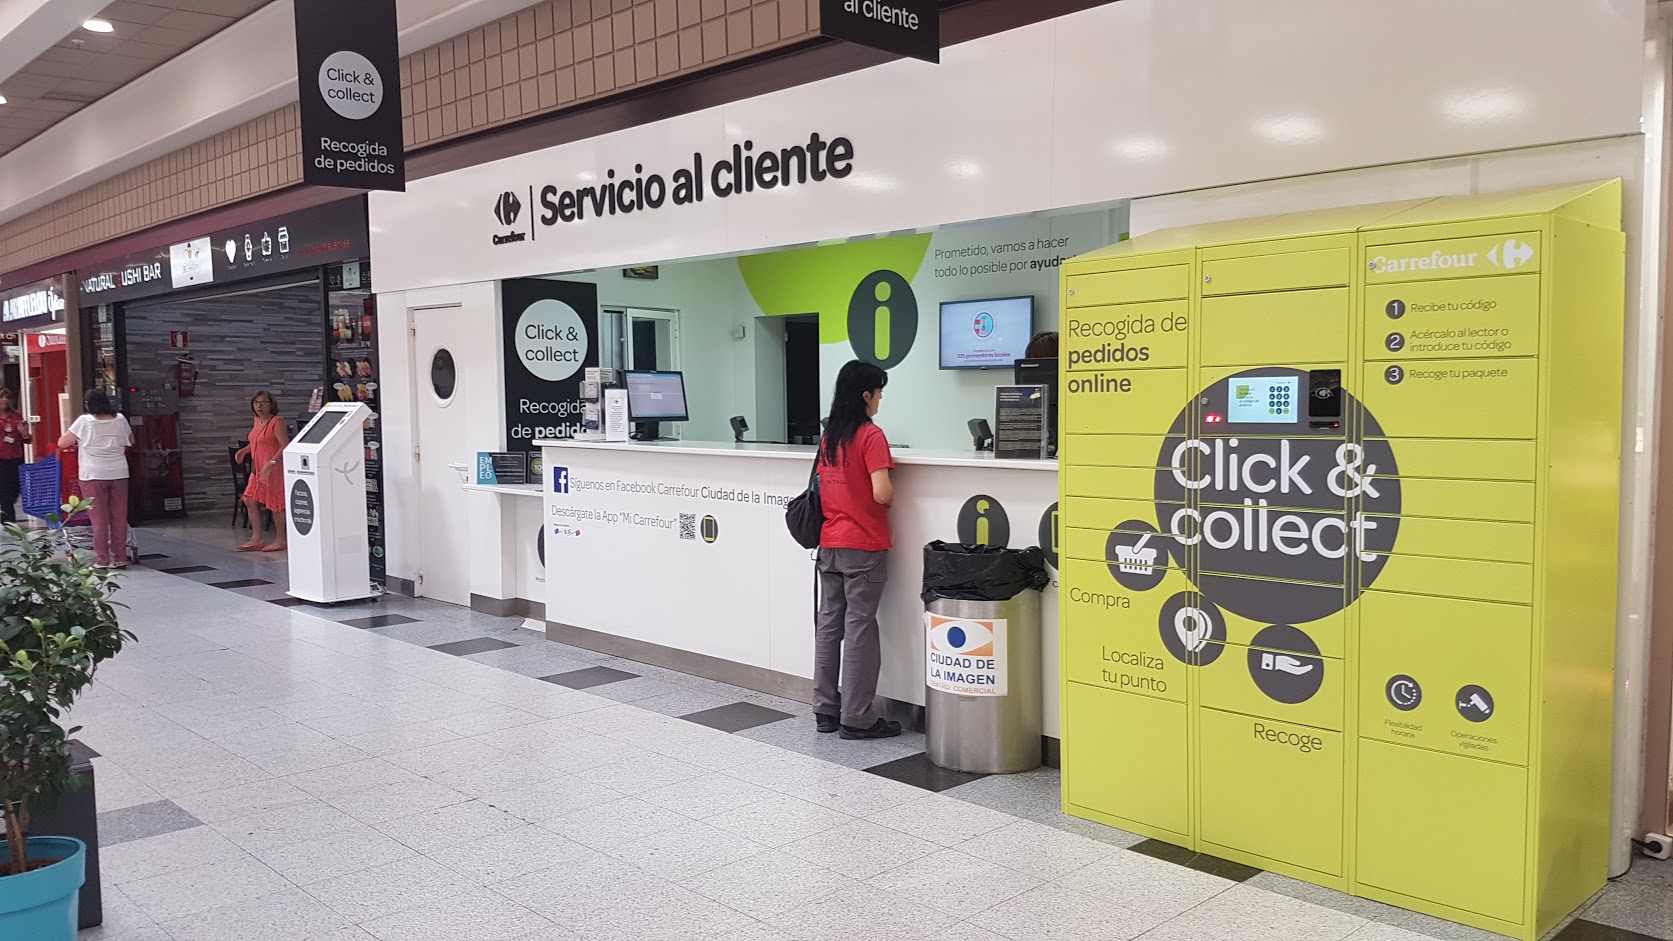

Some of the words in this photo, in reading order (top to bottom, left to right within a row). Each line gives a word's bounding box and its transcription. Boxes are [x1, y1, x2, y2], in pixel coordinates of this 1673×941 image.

[862, 0, 919, 30] cliente
[326, 67, 361, 84] Click
[363, 72, 375, 86] &
[327, 87, 375, 104] collect
[320, 137, 388, 158] Recogida
[314, 155, 335, 169] de
[337, 158, 395, 174] pedidos
[540, 163, 666, 226] Servicio
[671, 152, 704, 206] al
[710, 132, 854, 198] cliente
[492, 231, 527, 246] Carrefour
[934, 244, 989, 260] Prometido,
[990, 241, 1027, 254] vamos
[1028, 241, 1035, 251] a
[1036, 236, 1070, 250] hacer
[934, 265, 958, 278] todo
[959, 265, 969, 276] lo
[970, 261, 1008, 277] posible
[1009, 260, 1028, 274] por
[1372, 250, 1478, 274] Carrefour
[81, 274, 116, 293] NATURAL
[143, 262, 162, 281] BAR
[1391, 302, 1399, 315] 1
[1410, 303, 1446, 313] Recibe
[1447, 302, 1459, 311] tu
[1460, 299, 1497, 312] código
[524, 324, 563, 341] Click
[566, 326, 579, 342] &
[1068, 313, 1155, 340] Recogida
[1160, 312, 1187, 333] de
[1410, 328, 1456, 340] Acércalo
[1457, 328, 1467, 338] al
[1468, 327, 1500, 337] lector
[1501, 328, 1509, 336] o
[1390, 335, 1400, 349] 2
[1410, 342, 1460, 352] introduce
[1461, 342, 1474, 351] tu
[1475, 340, 1512, 352] código
[525, 345, 580, 362] collect
[1068, 342, 1150, 369] pedidos
[1067, 373, 1132, 394] online
[1388, 368, 1399, 381] 3
[1409, 369, 1448, 381] Recoge
[1449, 369, 1461, 378] tu
[1462, 368, 1508, 380] paquete
[519, 399, 587, 418] Recogida
[511, 423, 532, 439] de
[479, 456, 493, 464] EM
[479, 464, 491, 472] PL
[1170, 438, 1313, 495] Click
[1326, 442, 1381, 499] &
[479, 472, 493, 480] EO
[569, 477, 605, 492] Síguenos
[605, 481, 616, 491] en
[616, 480, 657, 495] Facebook
[657, 483, 700, 498] Carrefour
[700, 485, 735, 501] Ciudad
[736, 488, 750, 503] de
[751, 490, 761, 504] la
[551, 504, 594, 522] Descárgate
[594, 508, 601, 520] la
[602, 510, 619, 525] App
[1170, 498, 1378, 562] collect
[1069, 587, 1131, 610] Compra
[930, 652, 972, 669] CIUDAD
[976, 659, 995, 670] DE
[1101, 645, 1165, 671] Localiza
[930, 666, 941, 679] LA
[943, 671, 996, 685] IMAGEN
[1101, 668, 1118, 684] tu
[1120, 672, 1168, 693] punto
[930, 680, 950, 690] CENTRO
[953, 685, 996, 695] COMERCIAL
[1384, 718, 1423, 732] Flexibilidad
[1390, 728, 1416, 739] horaria
[1253, 722, 1323, 753] Recoge
[1450, 730, 1498, 745] Operaciones
[1458, 740, 1489, 752] vigiladas
